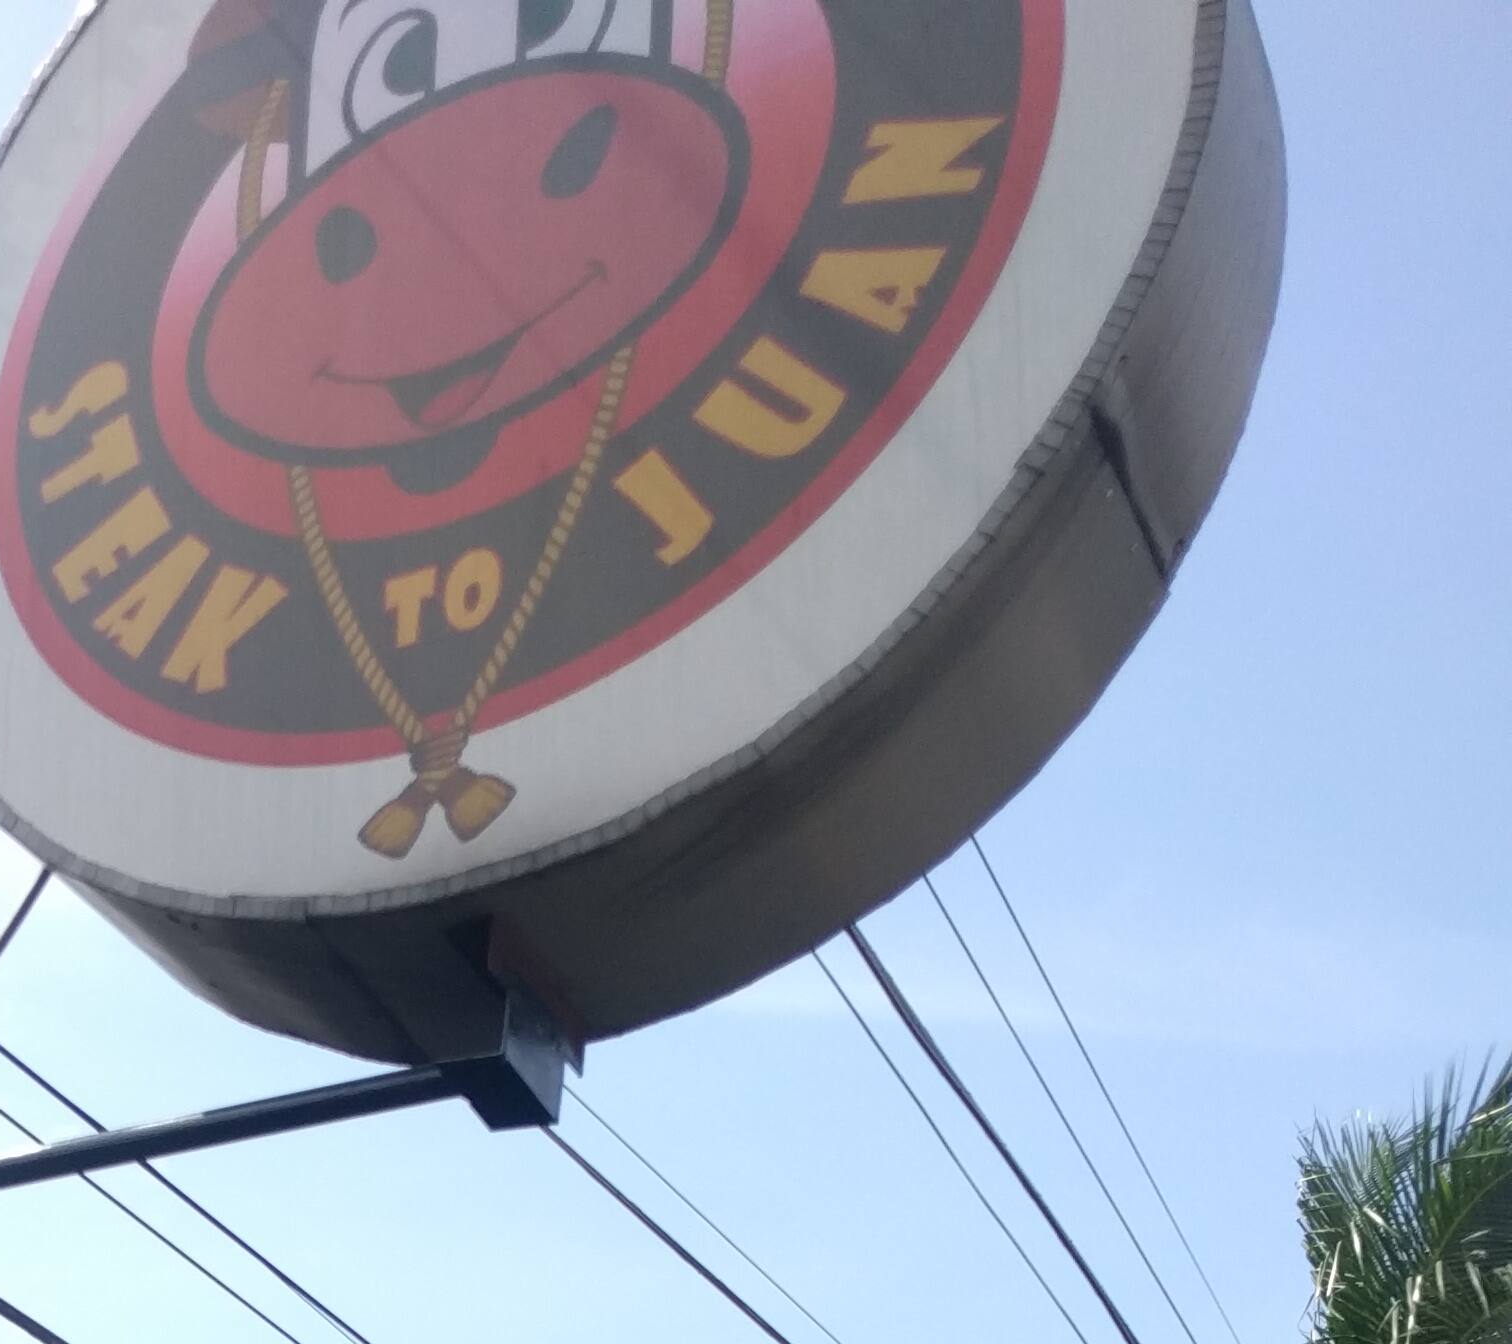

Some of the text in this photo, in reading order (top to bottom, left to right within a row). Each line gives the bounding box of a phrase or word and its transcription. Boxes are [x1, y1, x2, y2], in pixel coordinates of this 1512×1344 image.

[29, 117, 1006, 694] STEAK TO JUAN
